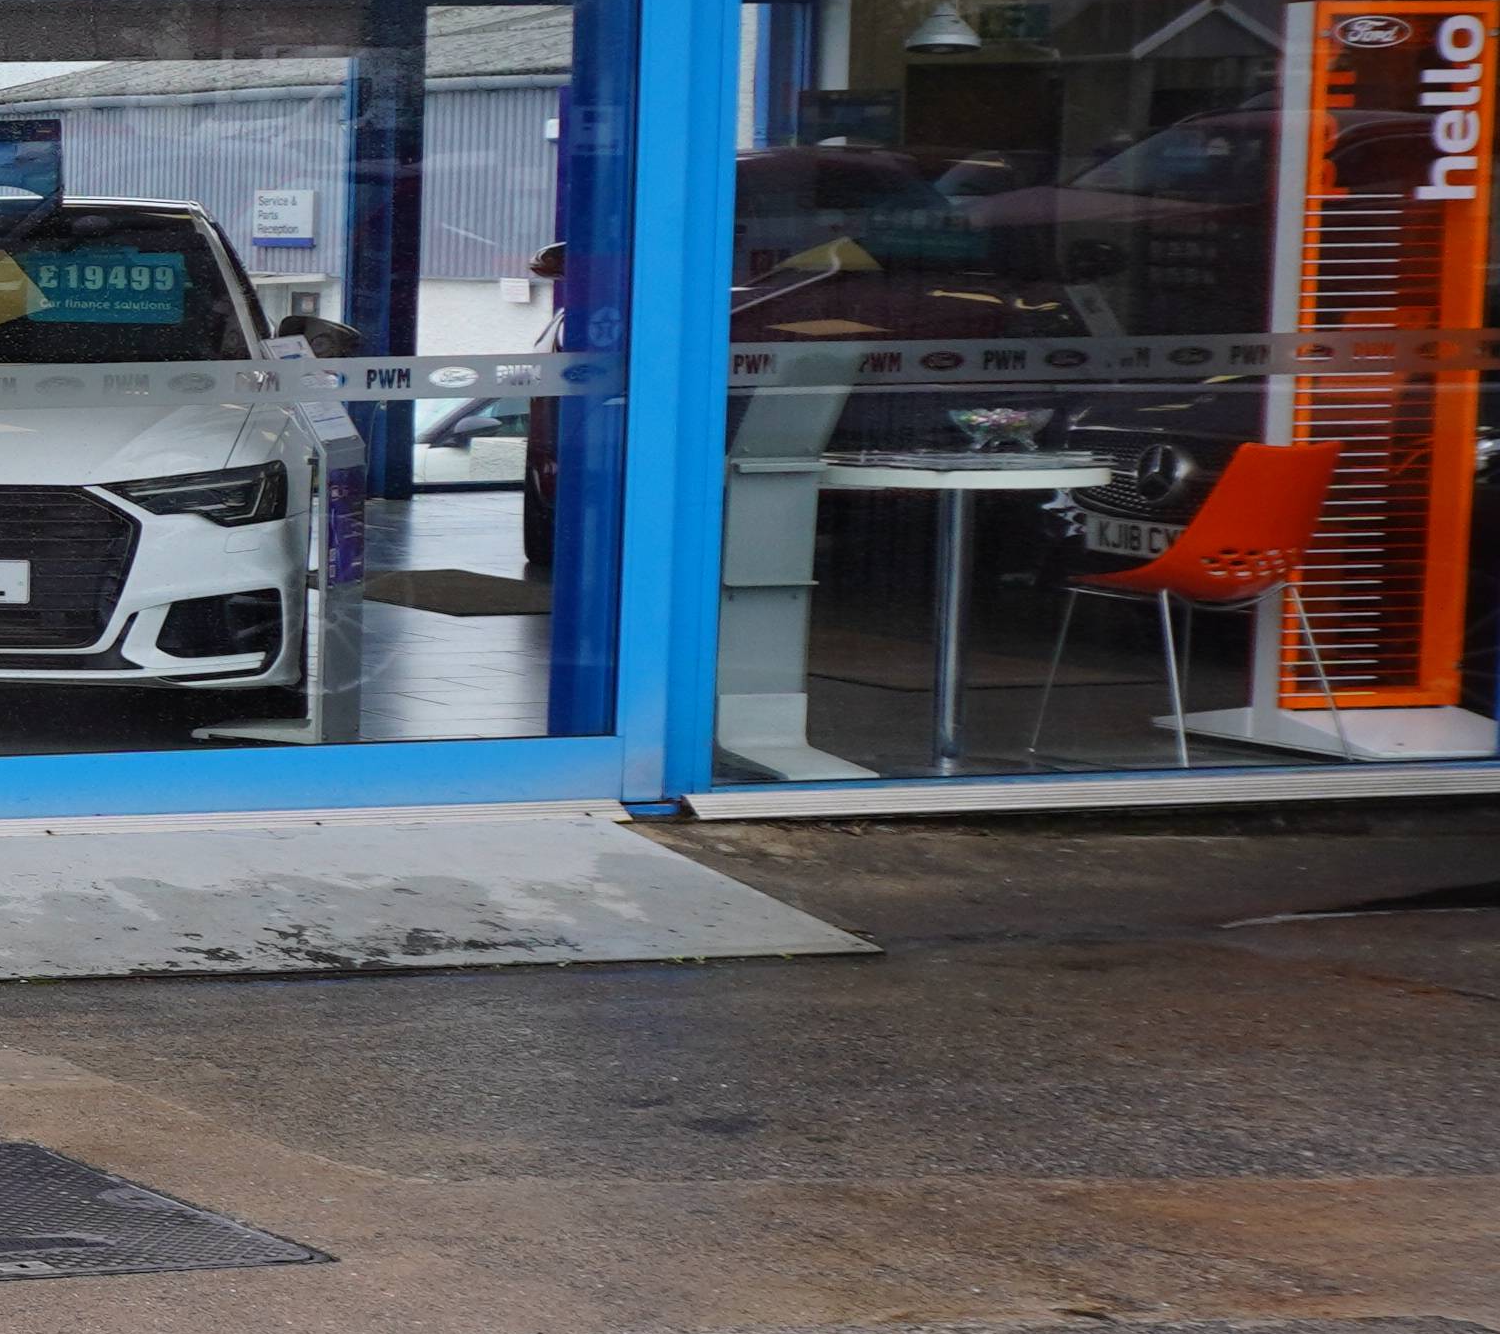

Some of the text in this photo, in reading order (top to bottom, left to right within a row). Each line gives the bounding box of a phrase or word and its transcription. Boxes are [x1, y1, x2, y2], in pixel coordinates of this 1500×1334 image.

[1346, 19, 1400, 43] Ford
[1414, 14, 1486, 200] hello
[257, 195, 288, 206] Service
[257, 209, 279, 220] Parts
[257, 223, 299, 235] Reception
[39, 264, 175, 291] £19499
[39, 298, 173, 311] Car finance solutions
[366, 368, 412, 390] PWM
[1099, 520, 1142, 551] KJ18
